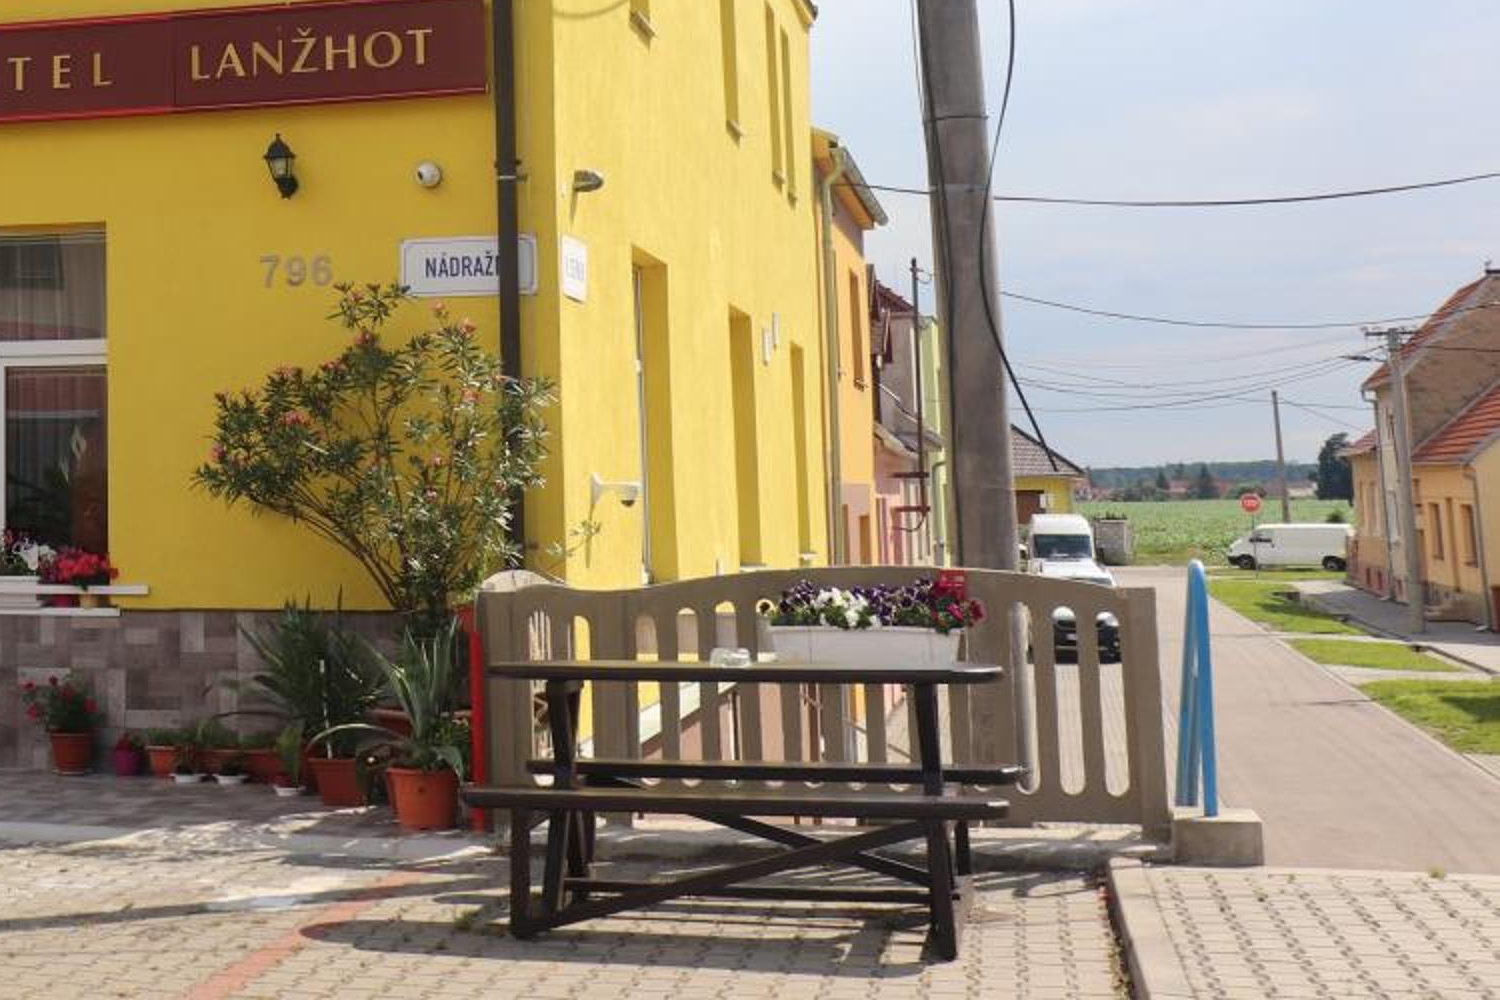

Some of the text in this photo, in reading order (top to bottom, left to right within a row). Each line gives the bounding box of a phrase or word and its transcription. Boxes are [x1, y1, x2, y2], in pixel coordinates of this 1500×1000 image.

[191, 27, 433, 81] LANŽHOT
[260, 255, 334, 288] 796
[425, 251, 500, 278] NÁDRAŽ
